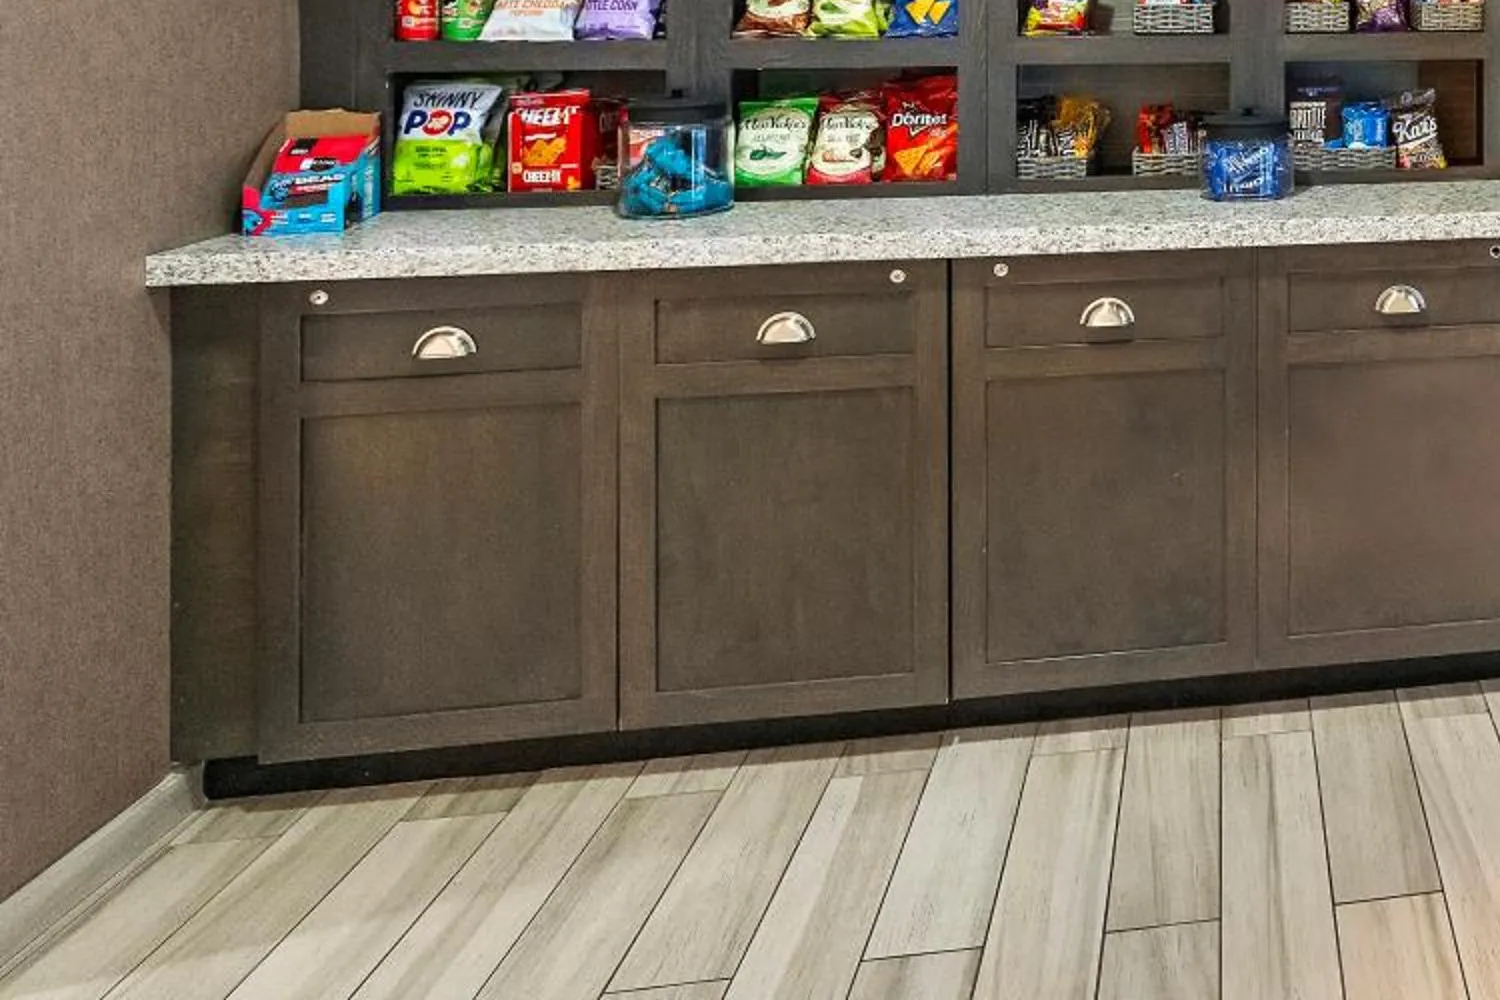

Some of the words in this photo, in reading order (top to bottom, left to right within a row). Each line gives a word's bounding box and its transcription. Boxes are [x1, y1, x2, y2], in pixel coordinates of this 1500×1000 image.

[413, 90, 485, 109] SKINNY
[403, 108, 473, 137] POP
[892, 111, 948, 128] Doritos
